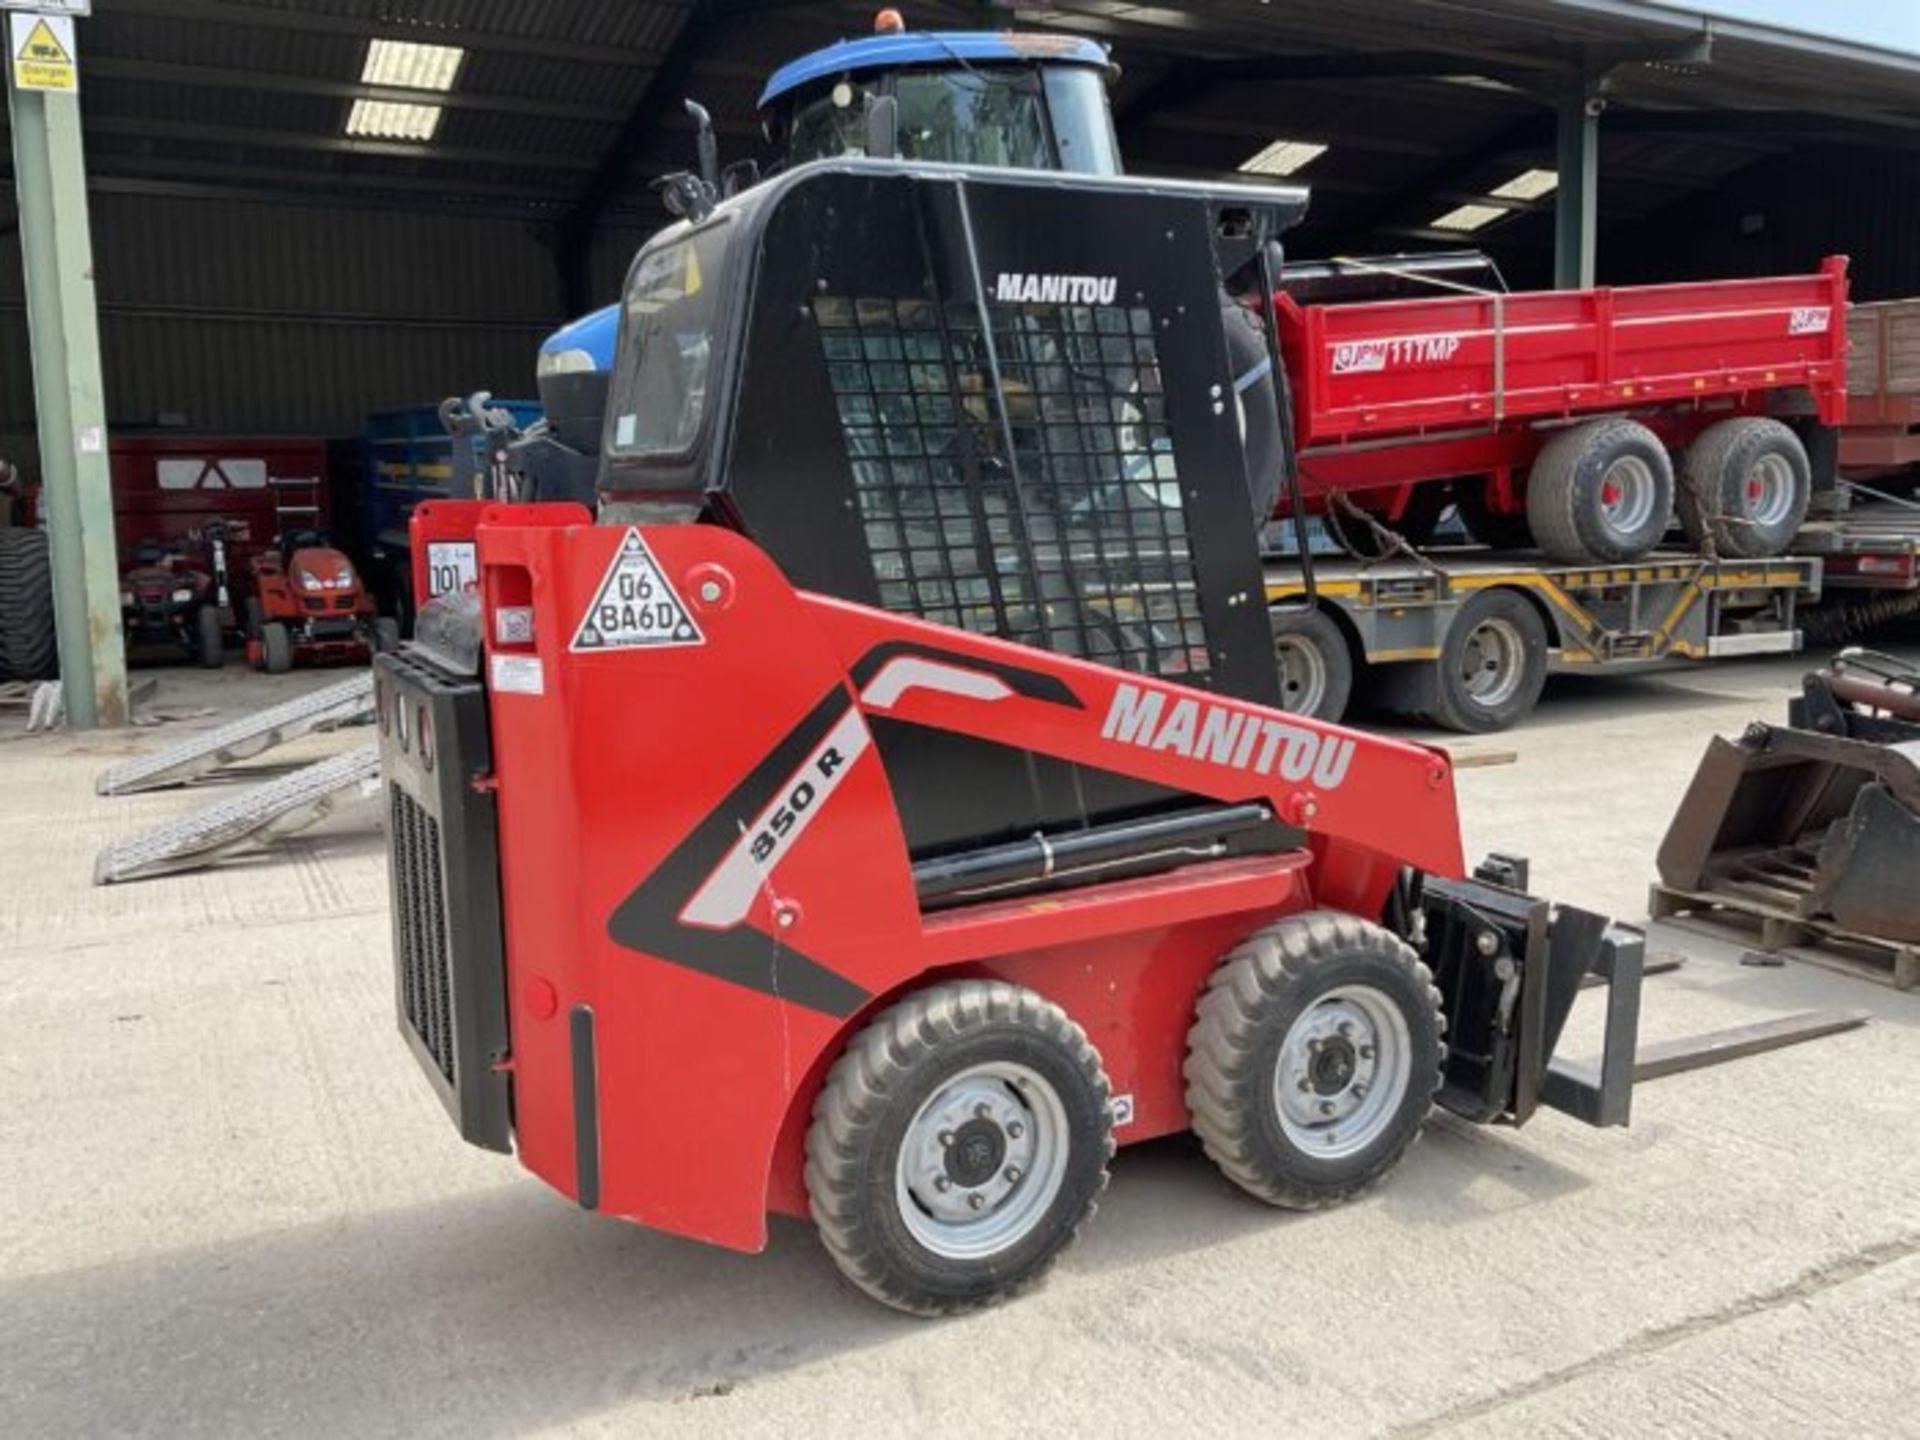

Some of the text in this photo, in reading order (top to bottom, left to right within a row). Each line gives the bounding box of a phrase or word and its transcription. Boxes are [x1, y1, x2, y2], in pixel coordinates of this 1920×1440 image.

[996, 273, 1117, 304] MANITOU
[432, 564, 460, 592] 101
[1101, 682, 1356, 790] MANITOU
[750, 746, 845, 863] 850 R
